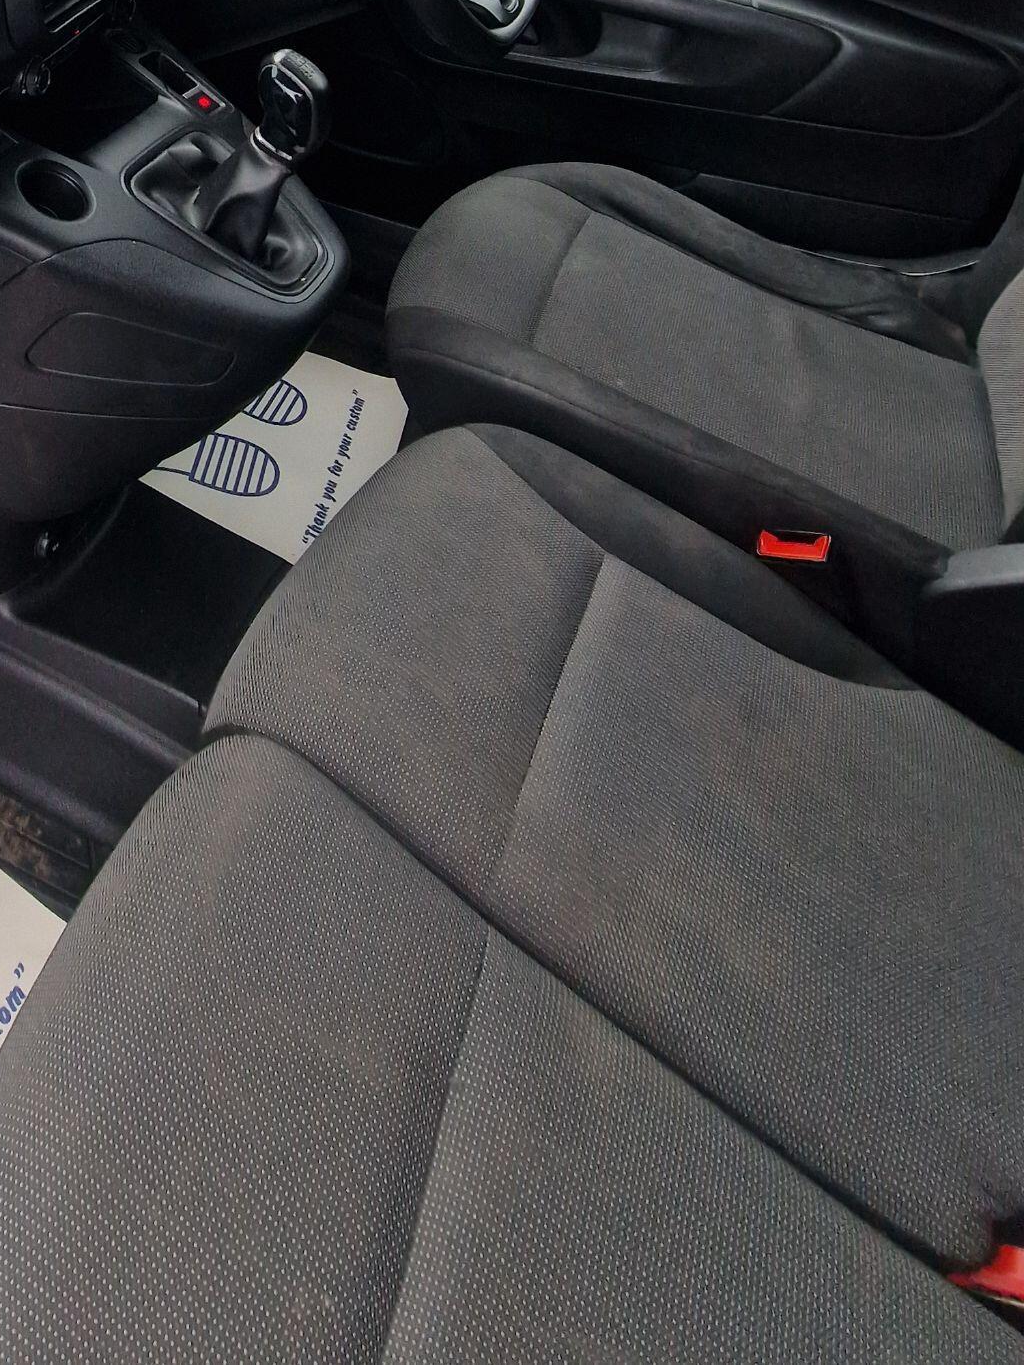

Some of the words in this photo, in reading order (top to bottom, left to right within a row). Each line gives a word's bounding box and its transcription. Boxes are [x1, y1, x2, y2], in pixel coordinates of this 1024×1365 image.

[336, 433, 353, 460] your
[327, 459, 345, 477] for
[321, 479, 338, 503] you
